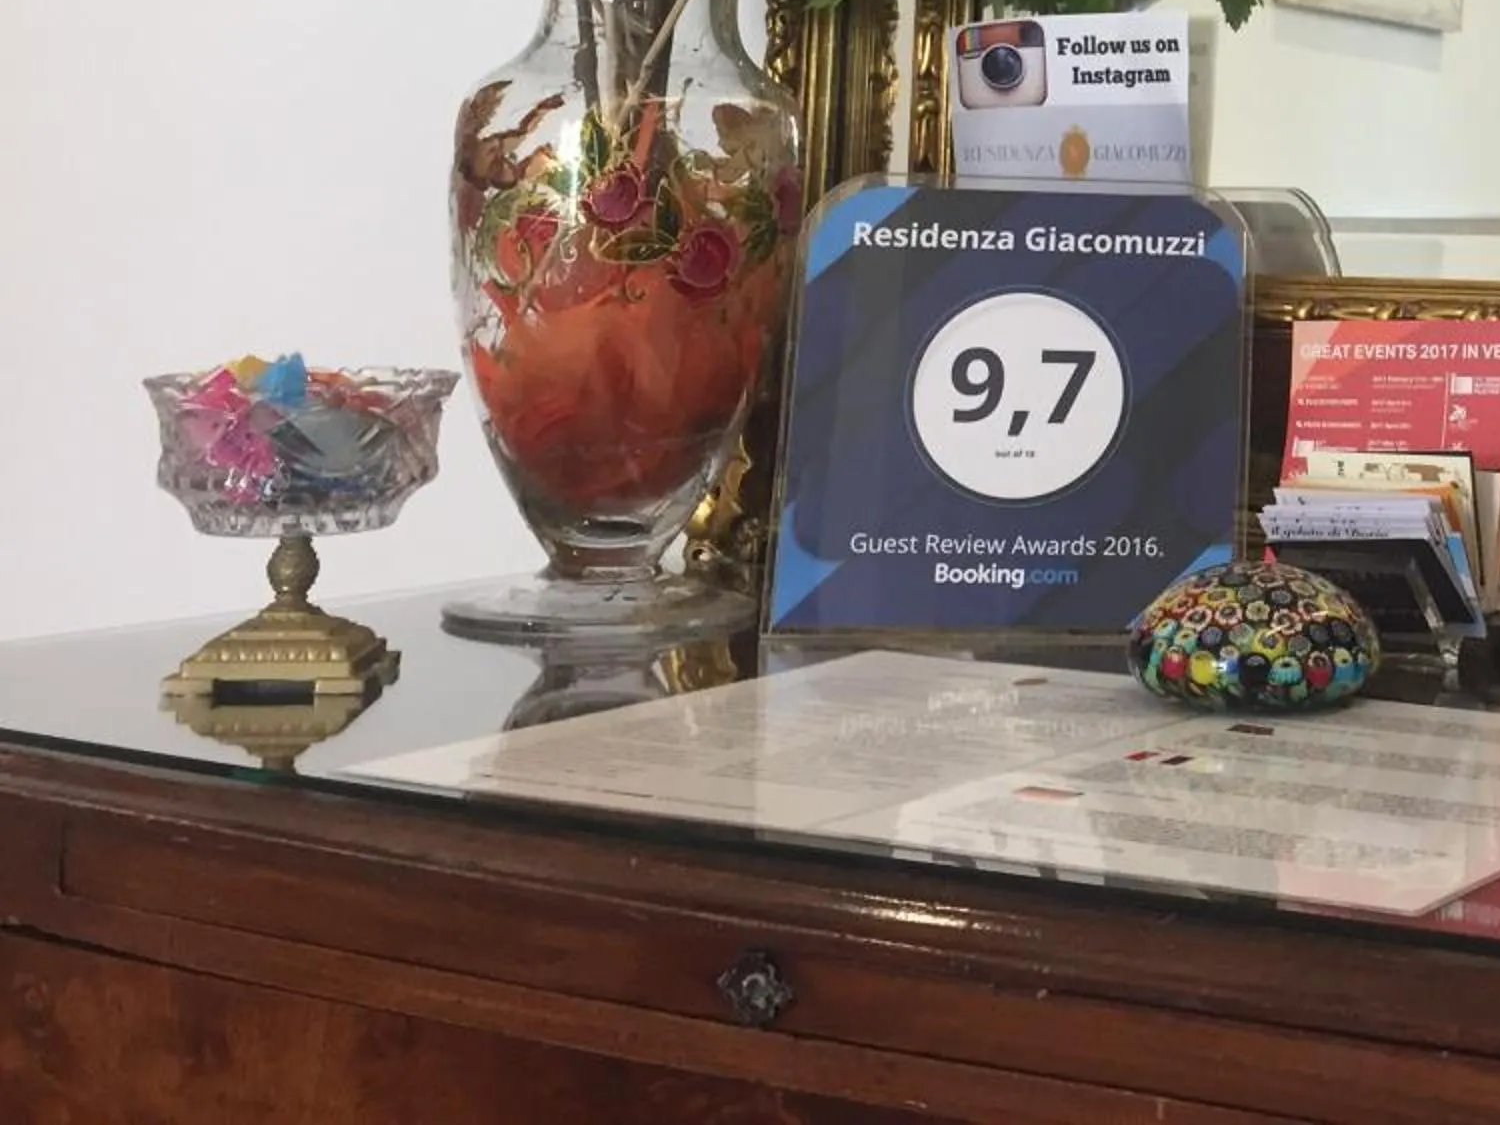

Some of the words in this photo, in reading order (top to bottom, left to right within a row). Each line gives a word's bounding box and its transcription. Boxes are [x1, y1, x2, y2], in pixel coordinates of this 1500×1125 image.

[1056, 35, 1126, 56] Follow
[1129, 39, 1151, 54] us
[1155, 37, 1180, 53] on
[1071, 66, 1171, 88] Instagram
[852, 221, 1015, 251] Residenza
[1025, 226, 1206, 257] Giacomuzzi
[1300, 343, 1351, 360] GREAT
[1354, 343, 1417, 360] EVENTS
[1419, 343, 1458, 360] 2017
[1462, 343, 1479, 360] IN
[949, 346, 1097, 437] 9,7
[850, 532, 917, 555] Guest
[925, 533, 1007, 555] Review
[1011, 534, 1097, 557] Awards
[1103, 535, 1165, 558] 2016.
[934, 562, 1079, 589] Booking.com
